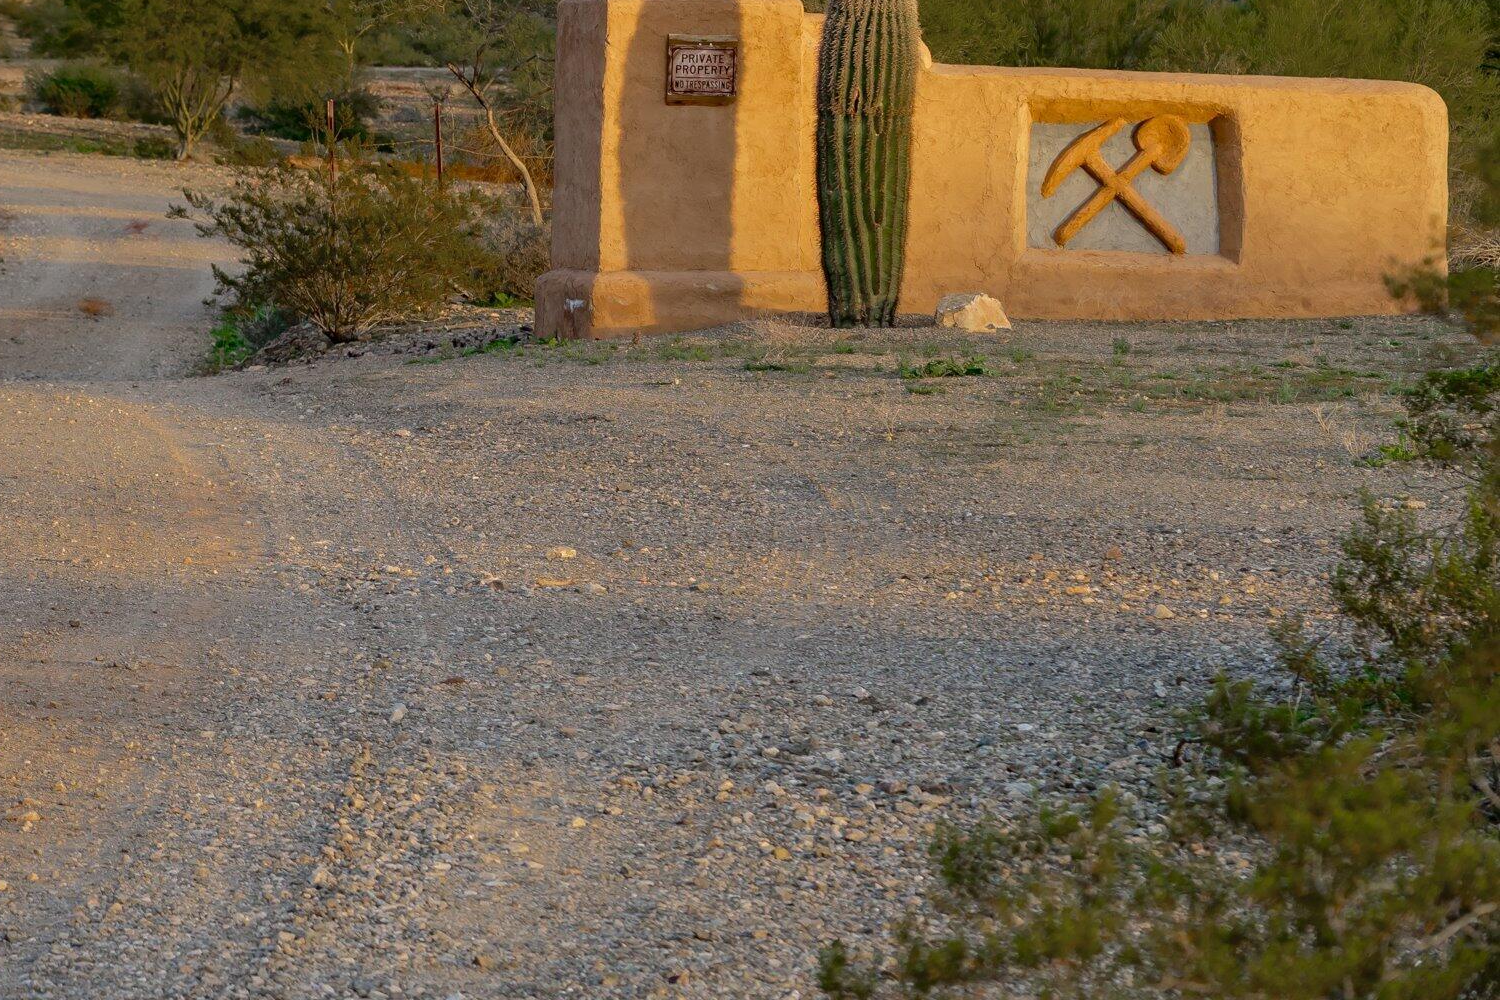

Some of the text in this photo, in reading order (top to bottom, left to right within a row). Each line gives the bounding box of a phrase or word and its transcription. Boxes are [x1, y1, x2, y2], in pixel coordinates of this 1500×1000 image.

[681, 53, 725, 64] PRIVATE
[675, 64, 730, 75] PROPERTY
[674, 80, 731, 90] NO TRESPASSING
